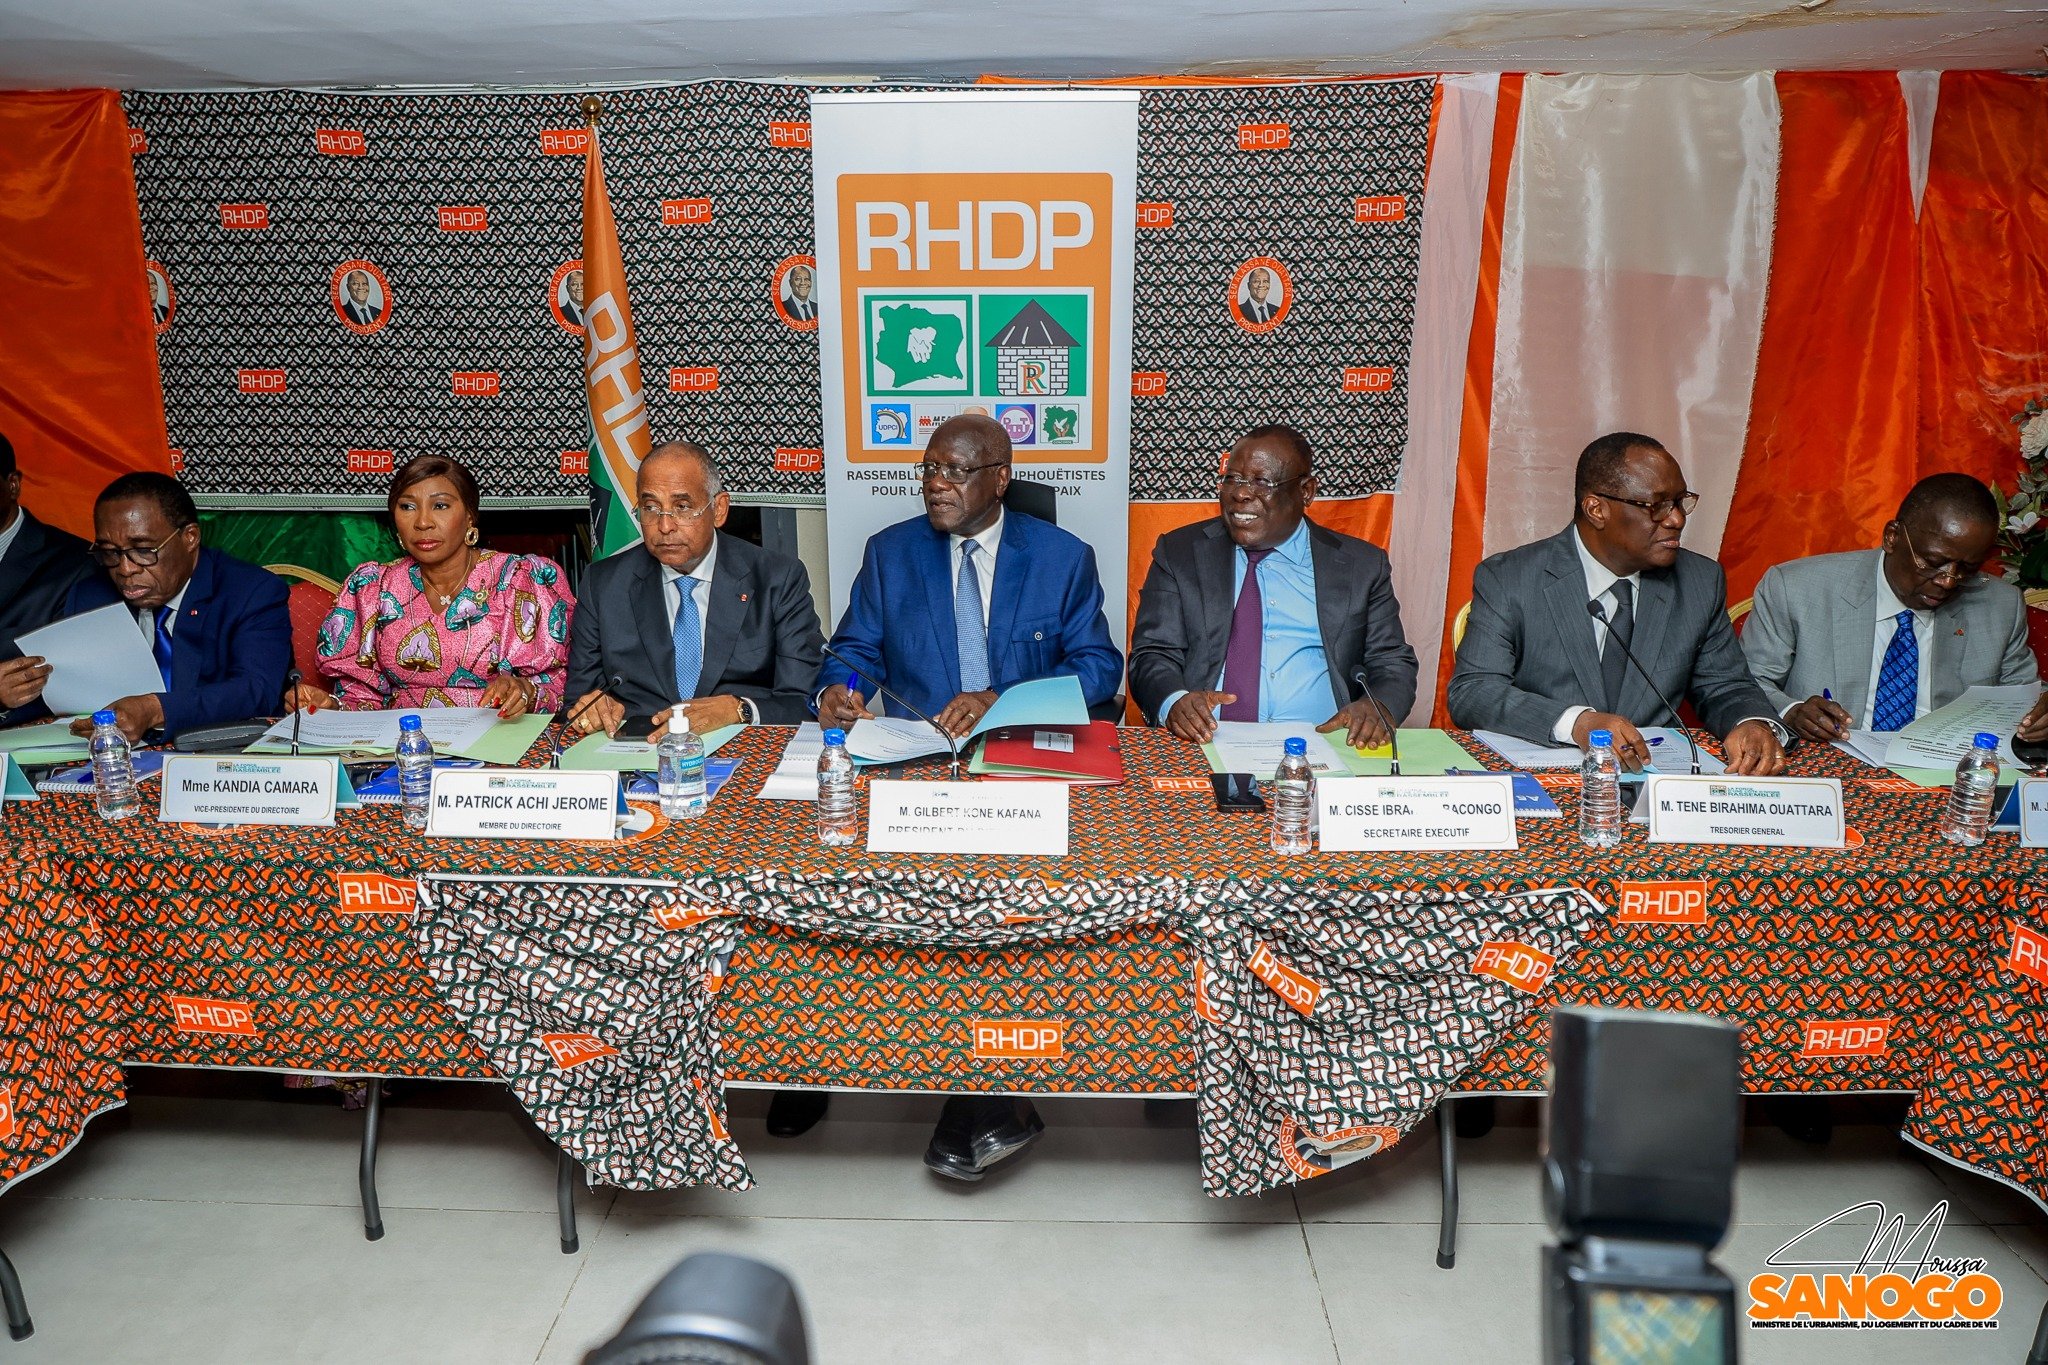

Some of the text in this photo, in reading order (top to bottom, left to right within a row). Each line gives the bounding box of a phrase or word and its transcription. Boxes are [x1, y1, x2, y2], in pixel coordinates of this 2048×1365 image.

[318, 134, 363, 151] RHDP
[543, 134, 588, 150] RHDP
[1240, 128, 1287, 145] RHDP
[222, 209, 265, 225] RHDP
[664, 203, 709, 220] RHDP
[1137, 207, 1171, 223] HDP
[1357, 201, 1402, 217] RHDP
[440, 211, 485, 227] RHDP
[855, 200, 1094, 271] RHDP
[344, 318, 385, 334] PRESIDENT
[1238, 315, 1281, 332] PRESIDENT
[240, 374, 284, 389] RHDP
[454, 376, 497, 391] RHDP
[672, 372, 716, 387] RHDP
[1345, 372, 1391, 388] RHDP
[350, 454, 391, 469] RHDP
[563, 456, 588, 470] RHD
[778, 453, 820, 467] RHDP
[847, 470, 915, 481] RASSEMBL
[872, 486, 906, 496] POUR
[182, 779, 319, 794] Mme KANDIA CAMARA
[1157, 780, 1211, 789] RHD
[194, 805, 300, 815] VICE-PRESIDENTE DU DIRECTOIRE
[437, 795, 608, 811] M. PATRICK ACHI JEROME
[1329, 805, 1342, 816] M.
[1345, 804, 1379, 816] CISSE
[1382, 804, 1413, 816] IBRA
[1661, 800, 1833, 817] M. TENE BIRAHIMA OUATTARA
[2031, 801, 2042, 812] M.
[899, 806, 911, 817] M.
[997, 808, 1042, 819] KAFANA
[479, 821, 562, 831] MEMBRE DU DIRECTOIRE
[1363, 828, 1470, 838] SECRETAIRE EXECUTIF
[1710, 826, 1785, 836] TRESORIER GENERAL
[1624, 890, 1702, 916] RHDP
[1477, 947, 1548, 984] RHDP
[1252, 946, 1314, 1006] RHDP
[176, 1003, 249, 1029] RHDP
[978, 1027, 1058, 1051] RHDP
[1808, 1026, 1884, 1051] RHDP
[548, 1038, 605, 1062] RHDP
[1281, 1120, 1318, 1178] RESIDENT
